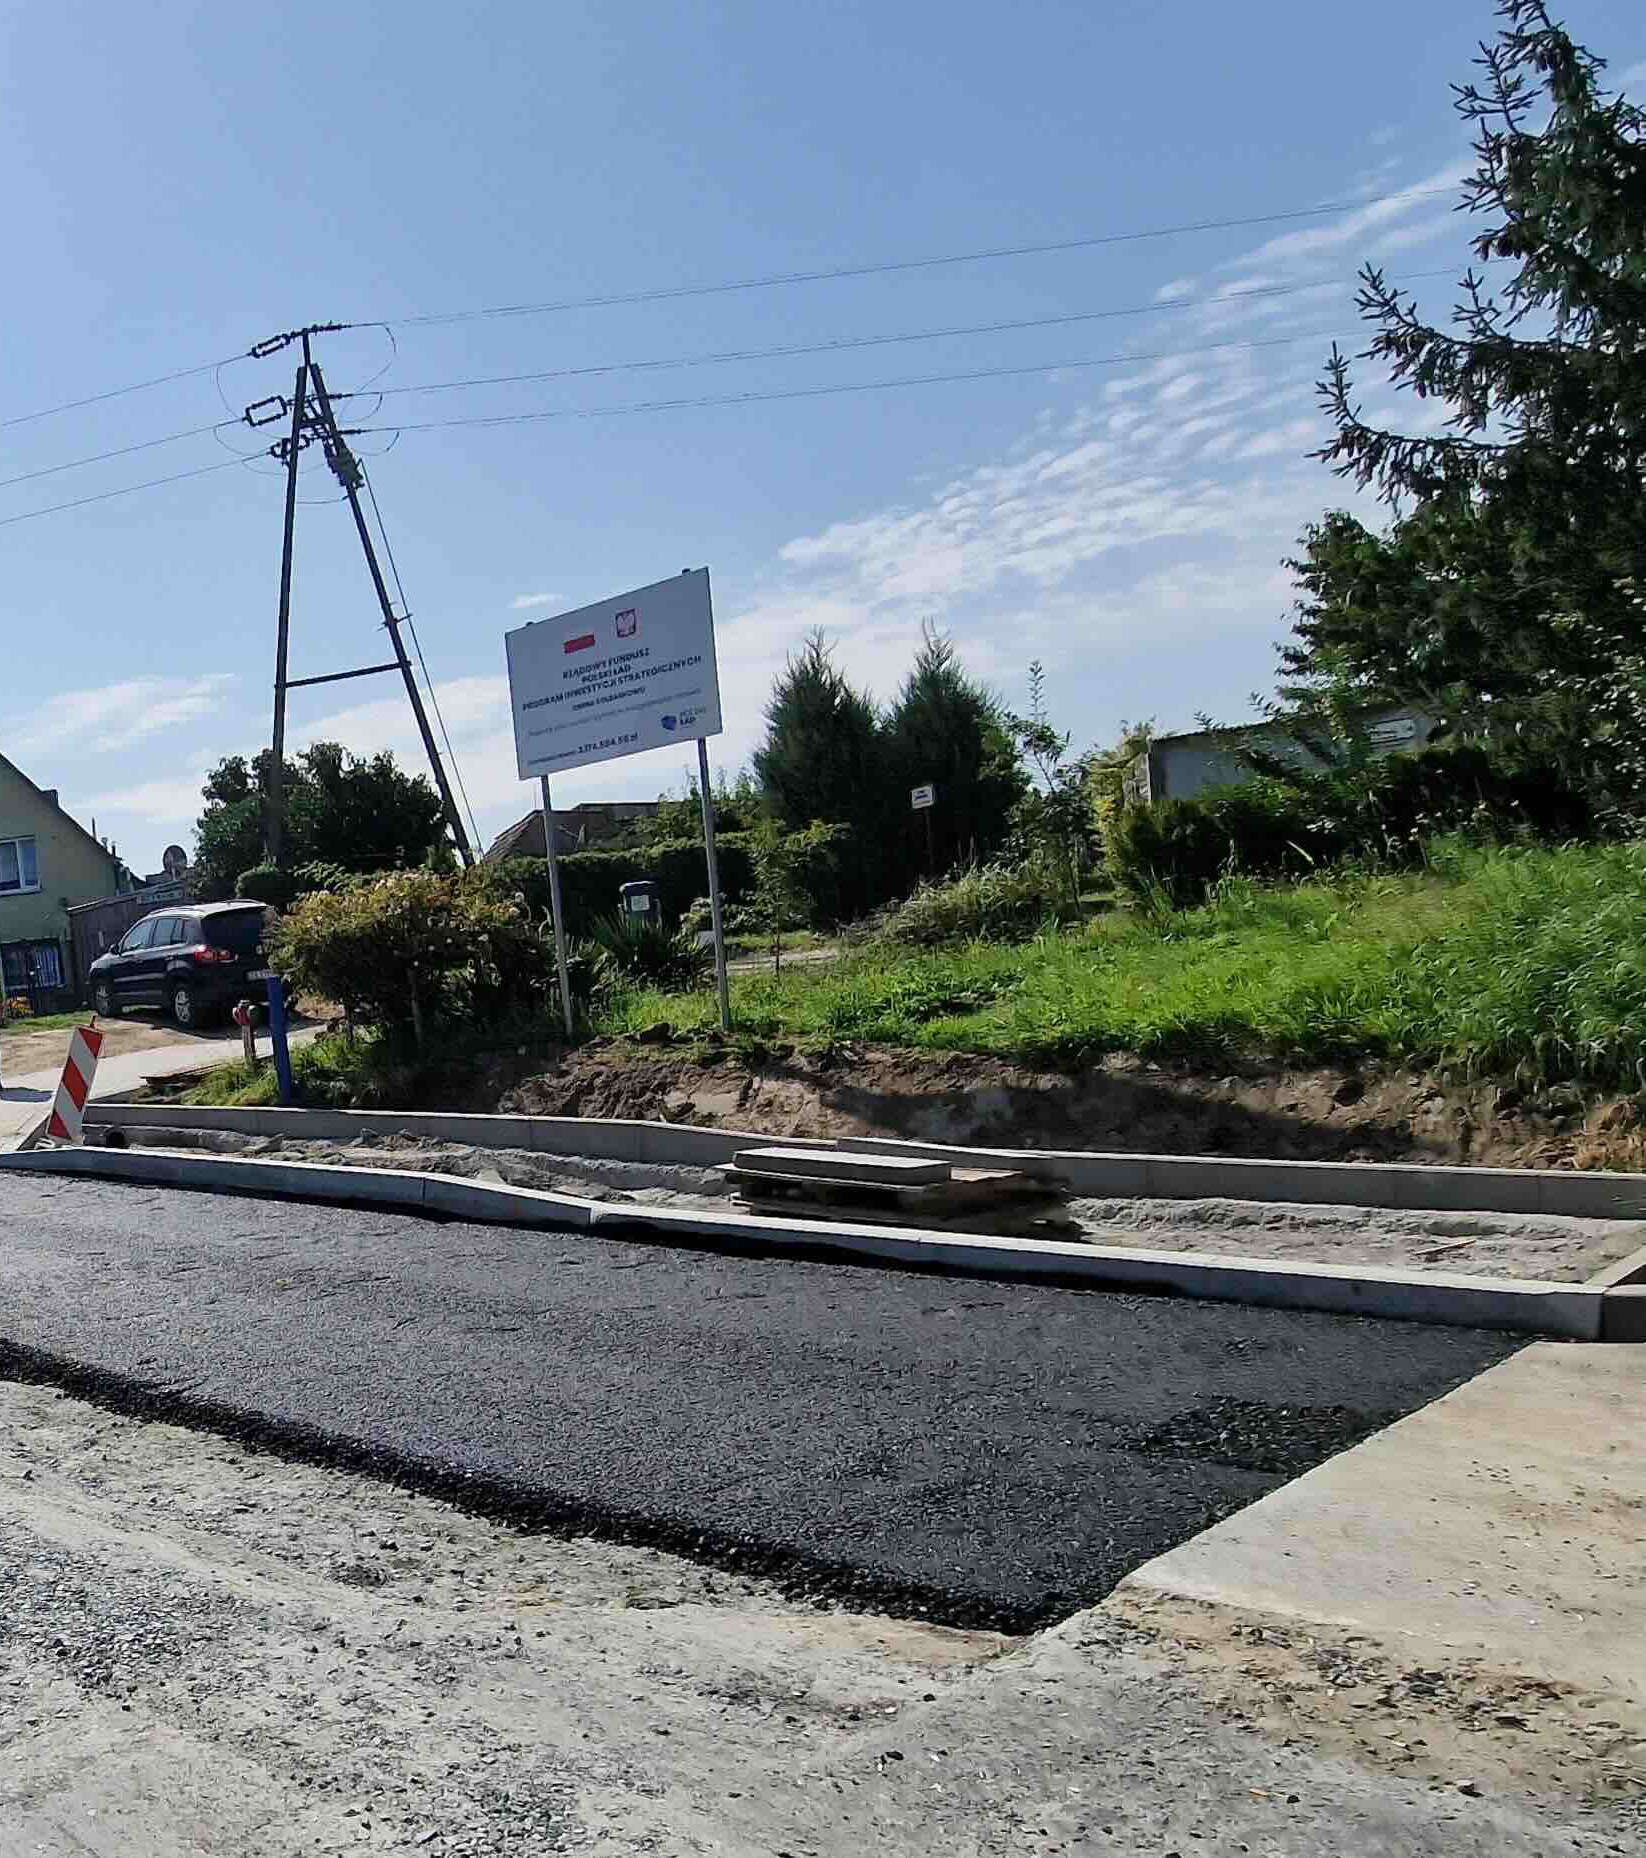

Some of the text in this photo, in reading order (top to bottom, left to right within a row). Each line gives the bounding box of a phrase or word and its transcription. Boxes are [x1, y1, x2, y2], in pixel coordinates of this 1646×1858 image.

[608, 648, 650, 668] FUNDUSZ
[522, 655, 702, 711] PROGRAM INWESTYCJI STRATEGICZNYCH
[582, 663, 632, 684] POLSKI ŁAD
